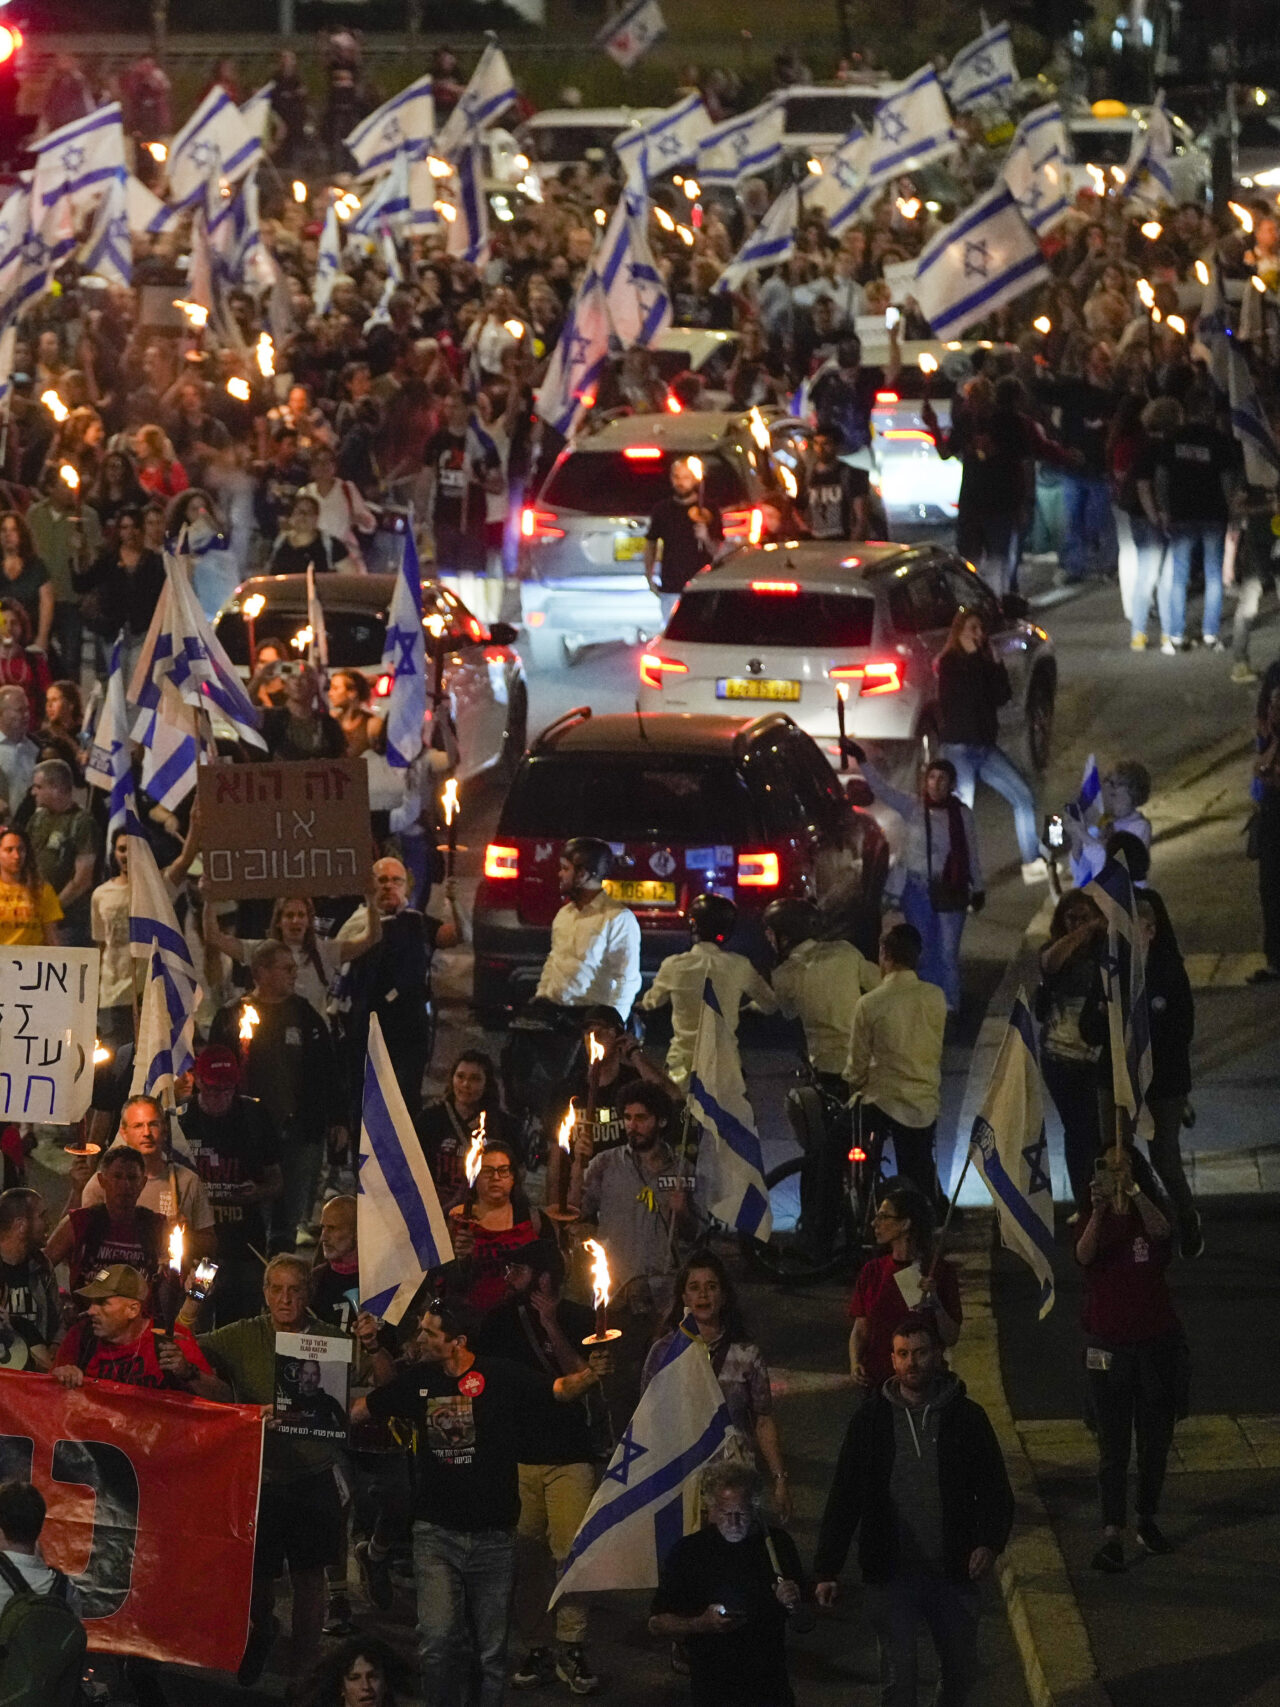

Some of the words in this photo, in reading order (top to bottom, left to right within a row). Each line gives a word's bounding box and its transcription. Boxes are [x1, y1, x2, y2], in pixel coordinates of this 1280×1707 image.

[217, 769, 282, 803] הוא
[305, 766, 351, 800] זה
[276, 810, 315, 839] או
[210, 847, 357, 882] החטופים
[13, 1035, 62, 1066] עד
